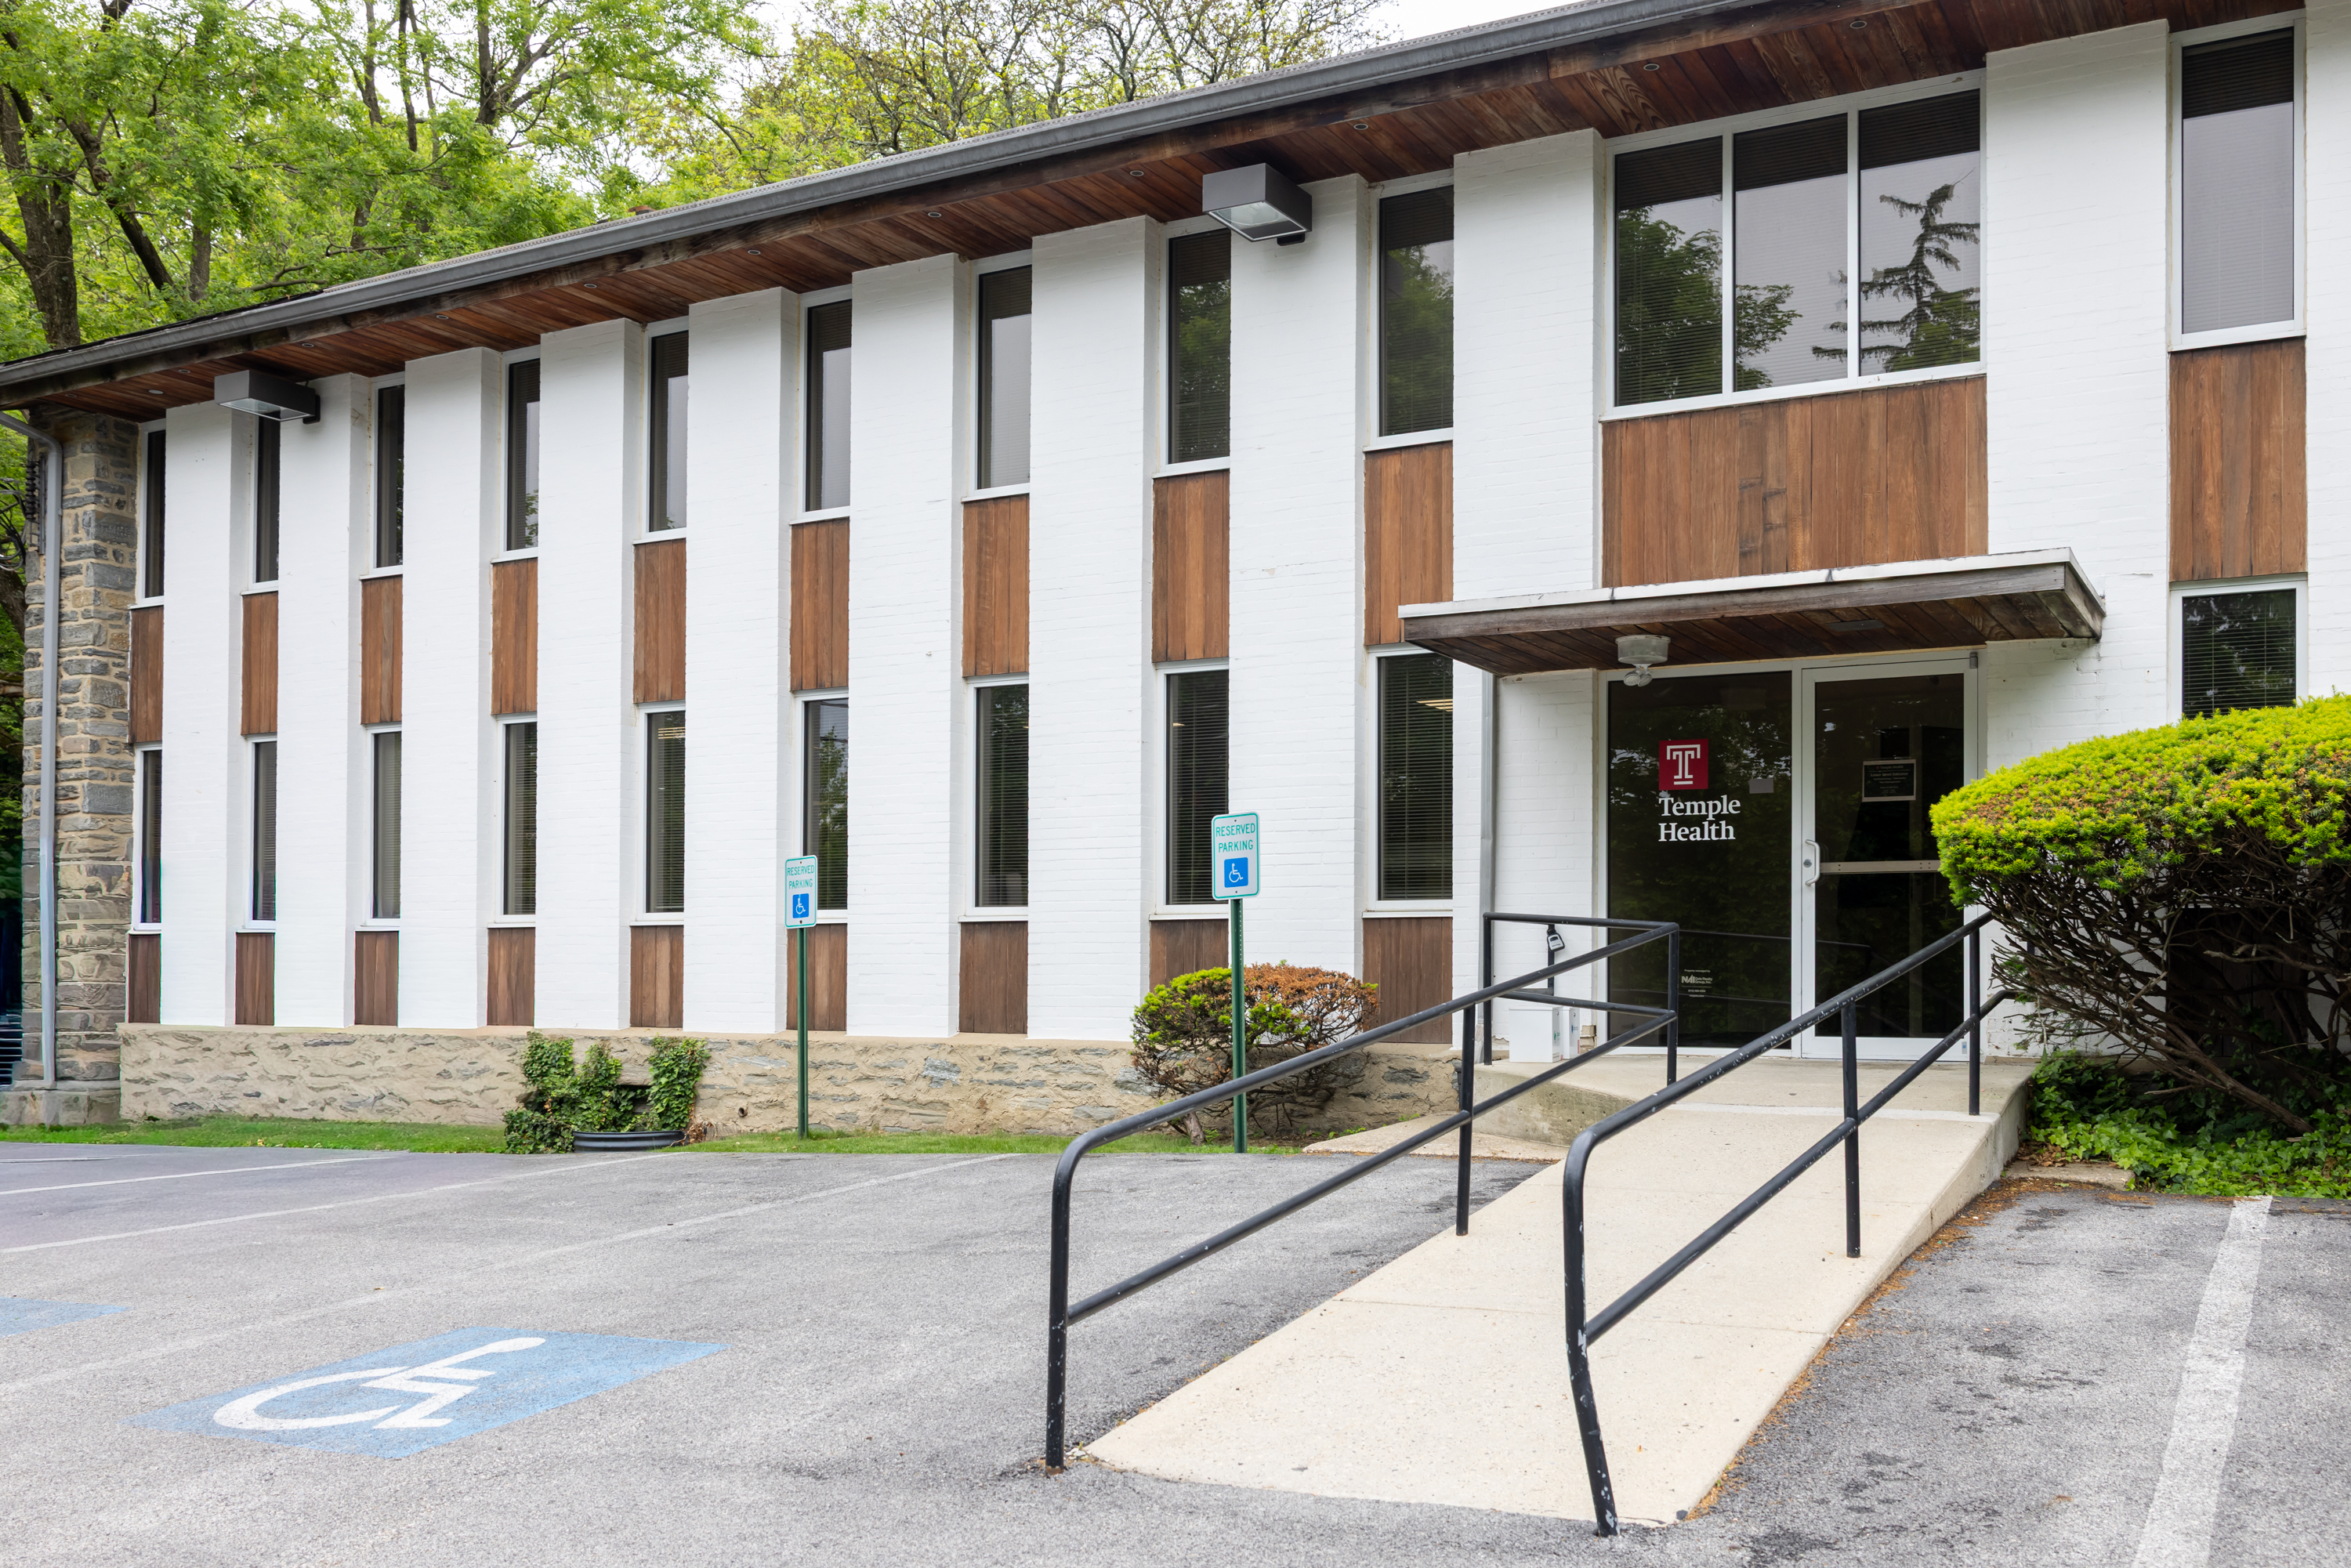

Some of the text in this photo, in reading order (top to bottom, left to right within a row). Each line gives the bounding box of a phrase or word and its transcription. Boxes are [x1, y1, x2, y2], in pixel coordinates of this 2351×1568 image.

[1658, 795, 1741, 820] Temple
[1215, 823, 1256, 837] RESERVED
[1658, 820, 1736, 842] Health
[1218, 839, 1254, 853] PARKING
[787, 864, 814, 876] RESERVED
[788, 878, 813, 889] PARKING
[1681, 974, 1695, 983] NAI
